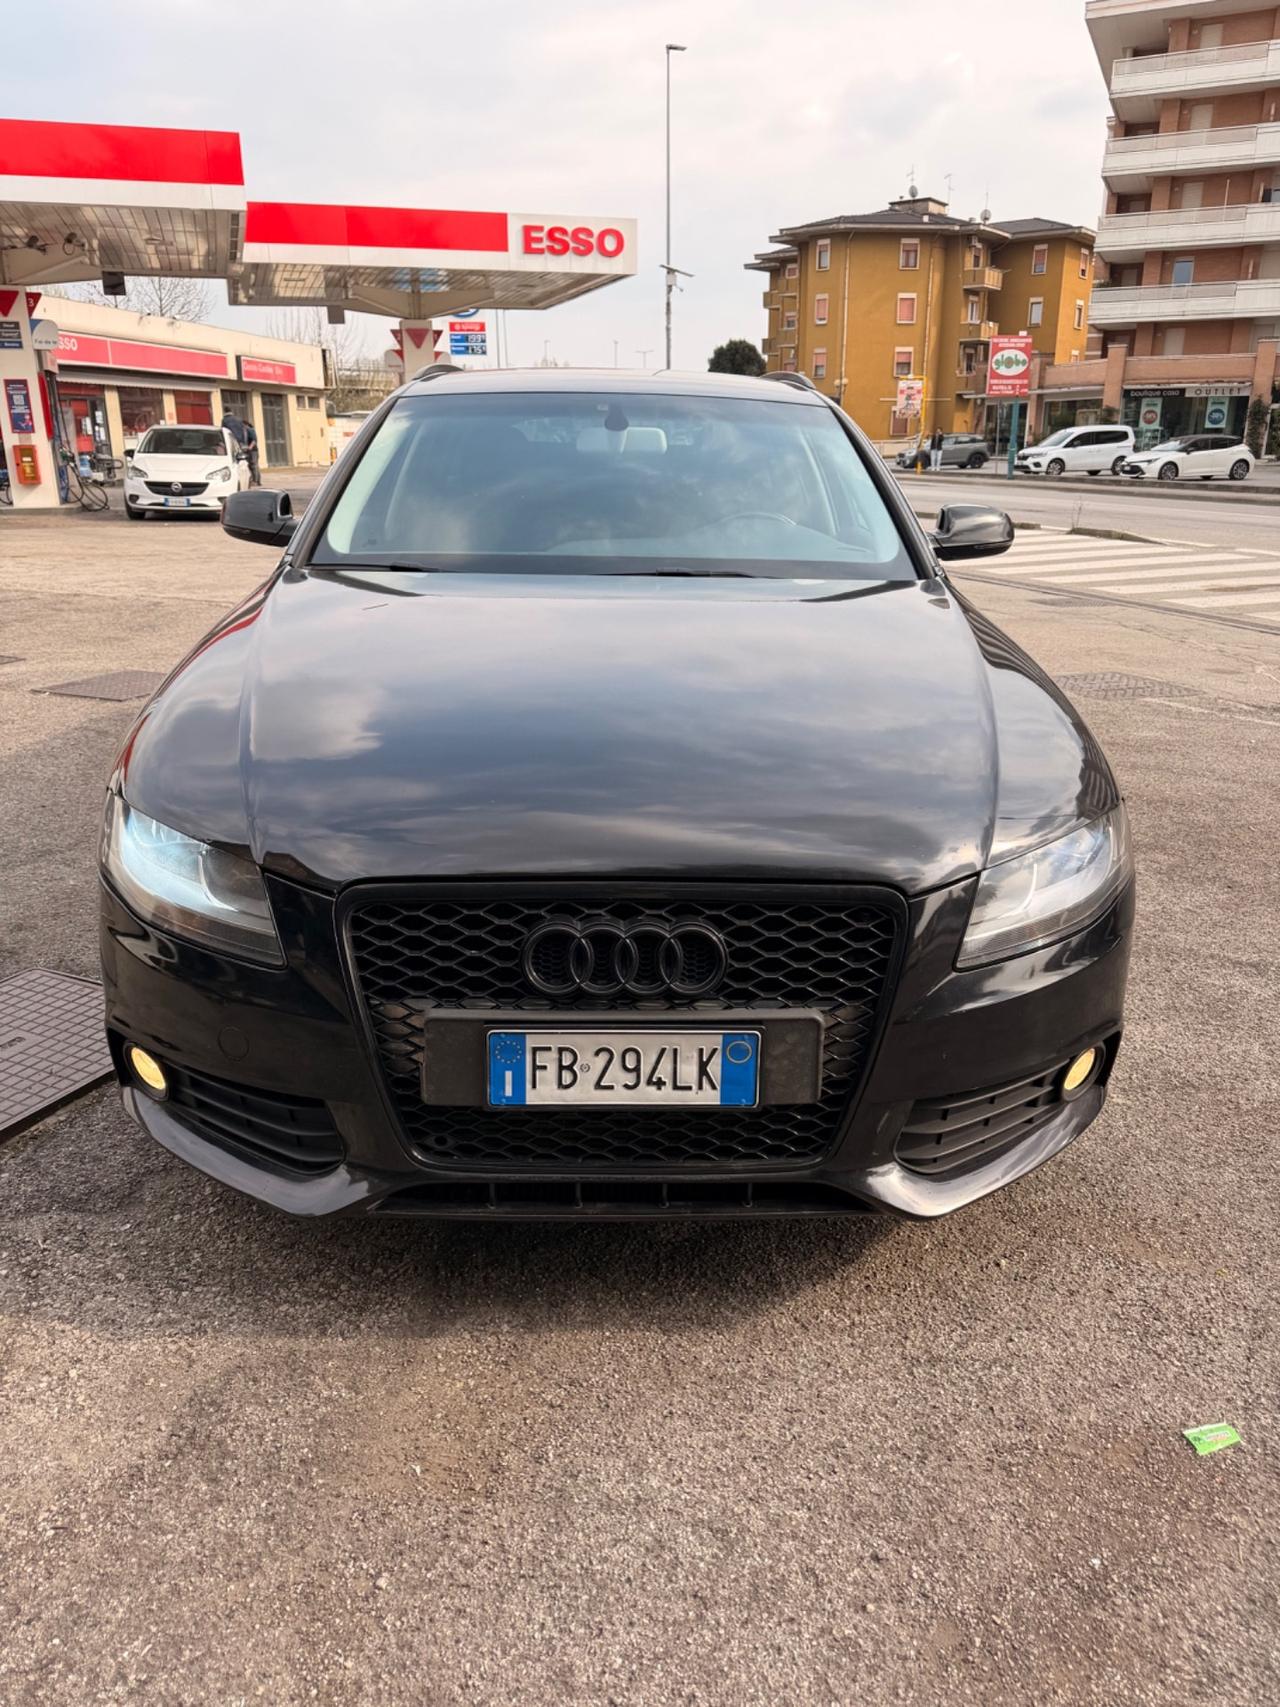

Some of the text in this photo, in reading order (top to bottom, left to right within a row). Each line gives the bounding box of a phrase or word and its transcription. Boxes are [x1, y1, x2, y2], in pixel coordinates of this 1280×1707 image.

[523, 225, 624, 257] ESSO
[58, 336, 78, 351] SSO
[1130, 389, 1162, 398] boutique
[1194, 386, 1241, 397] OUTLET
